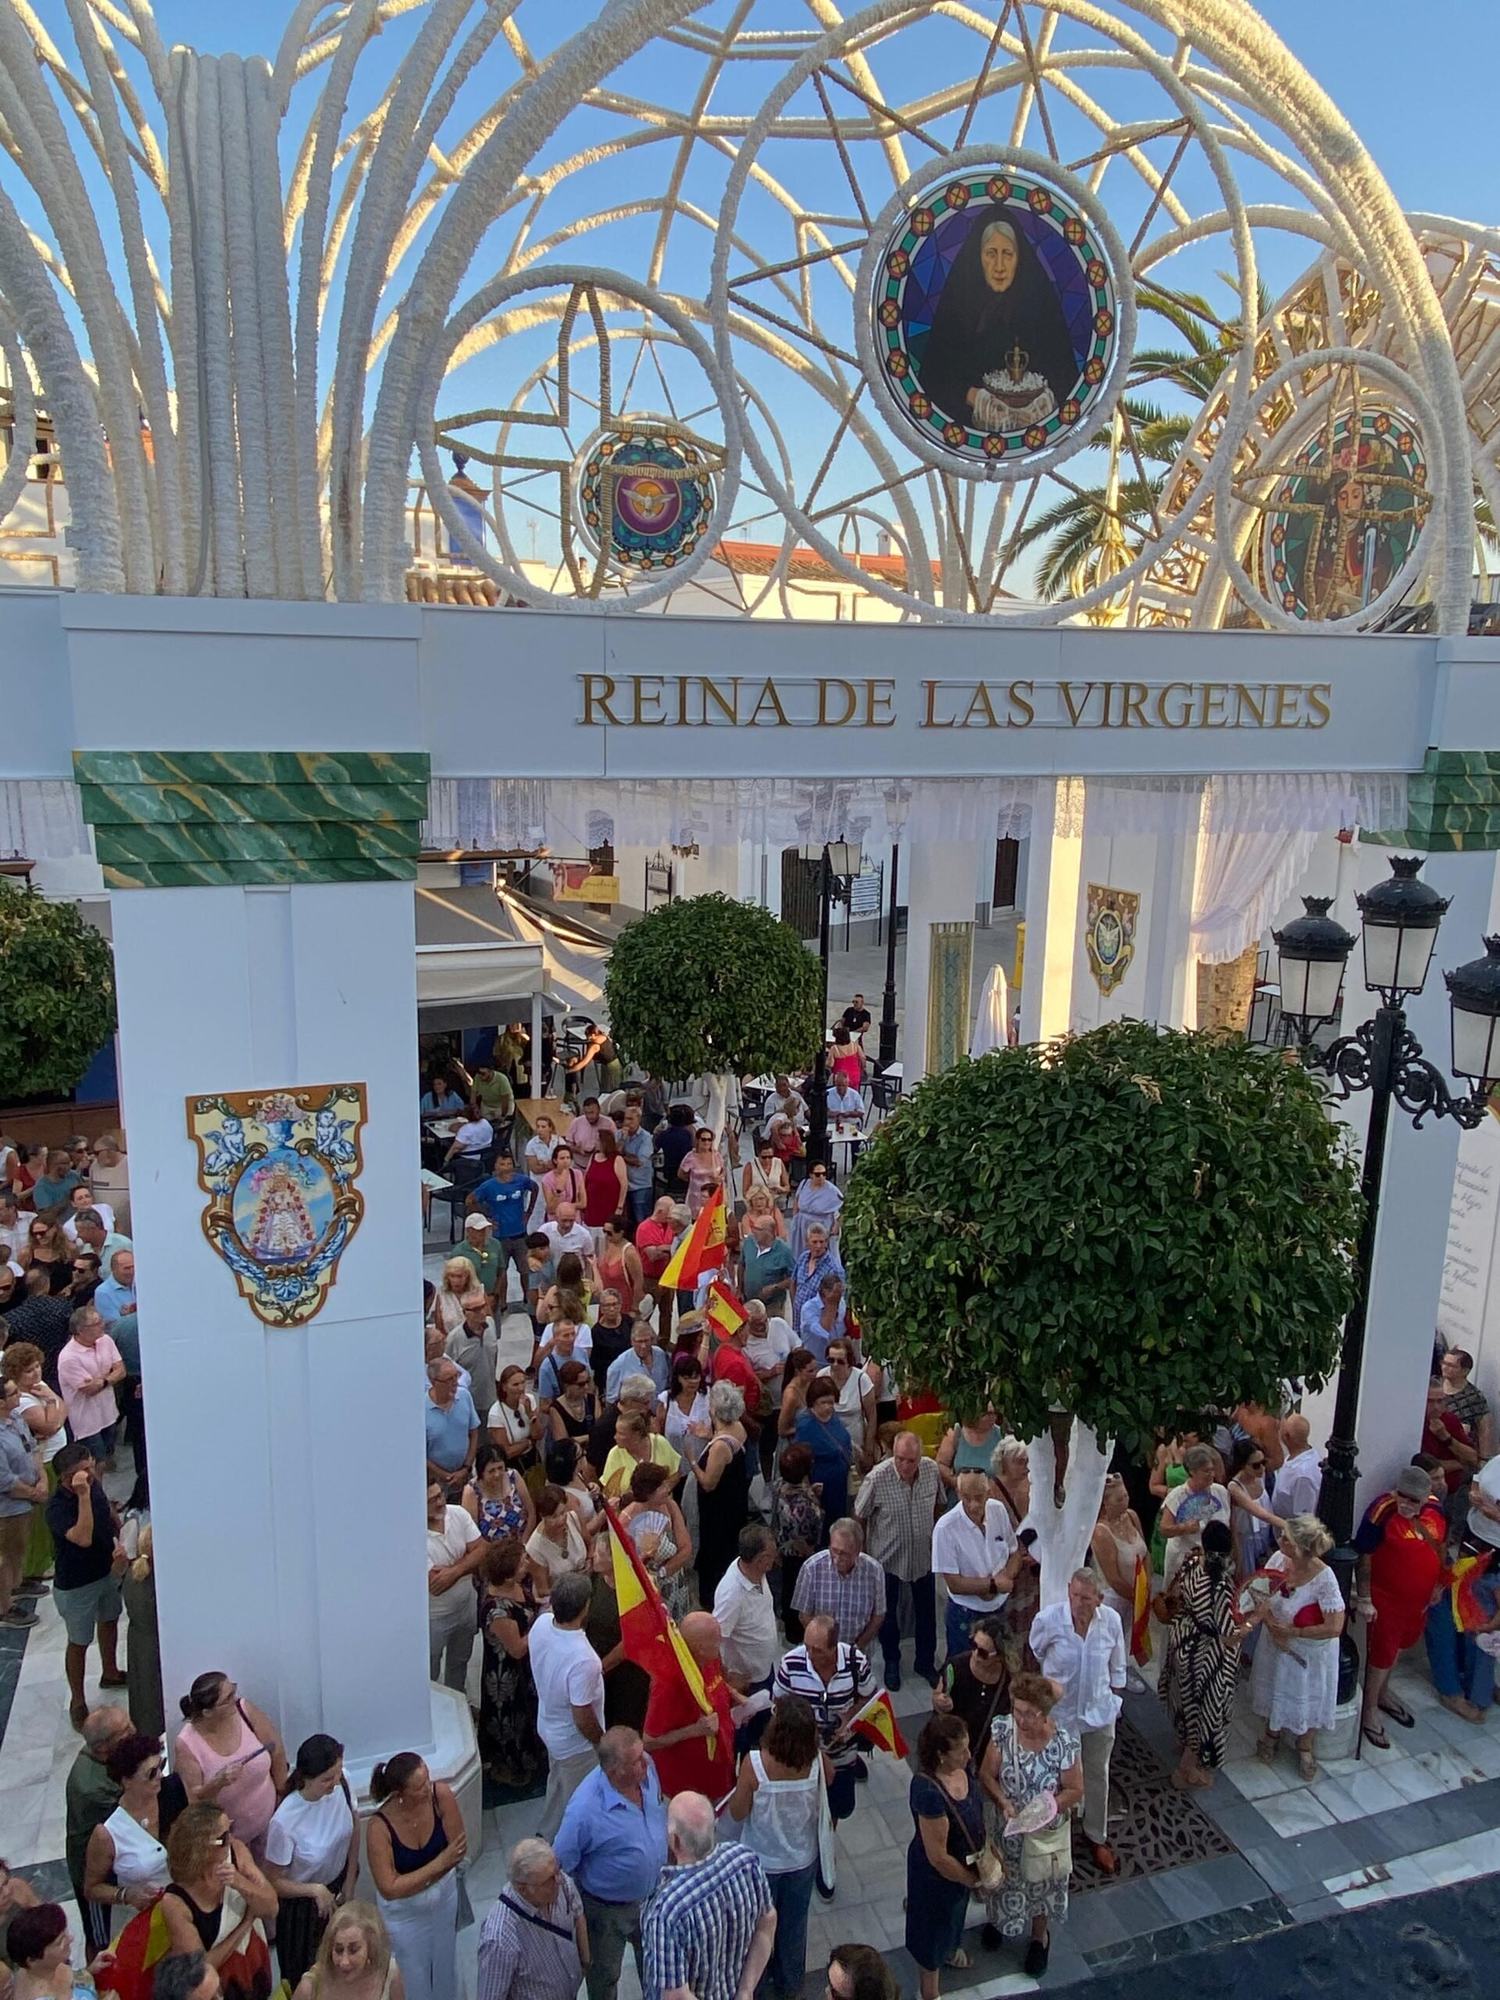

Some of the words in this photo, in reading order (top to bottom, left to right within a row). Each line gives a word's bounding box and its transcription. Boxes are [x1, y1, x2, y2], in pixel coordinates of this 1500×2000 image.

[577, 674, 792, 727] REINA
[814, 678, 897, 728] DE
[919, 680, 1034, 728] LAS
[1056, 681, 1331, 729] VIRGENES
